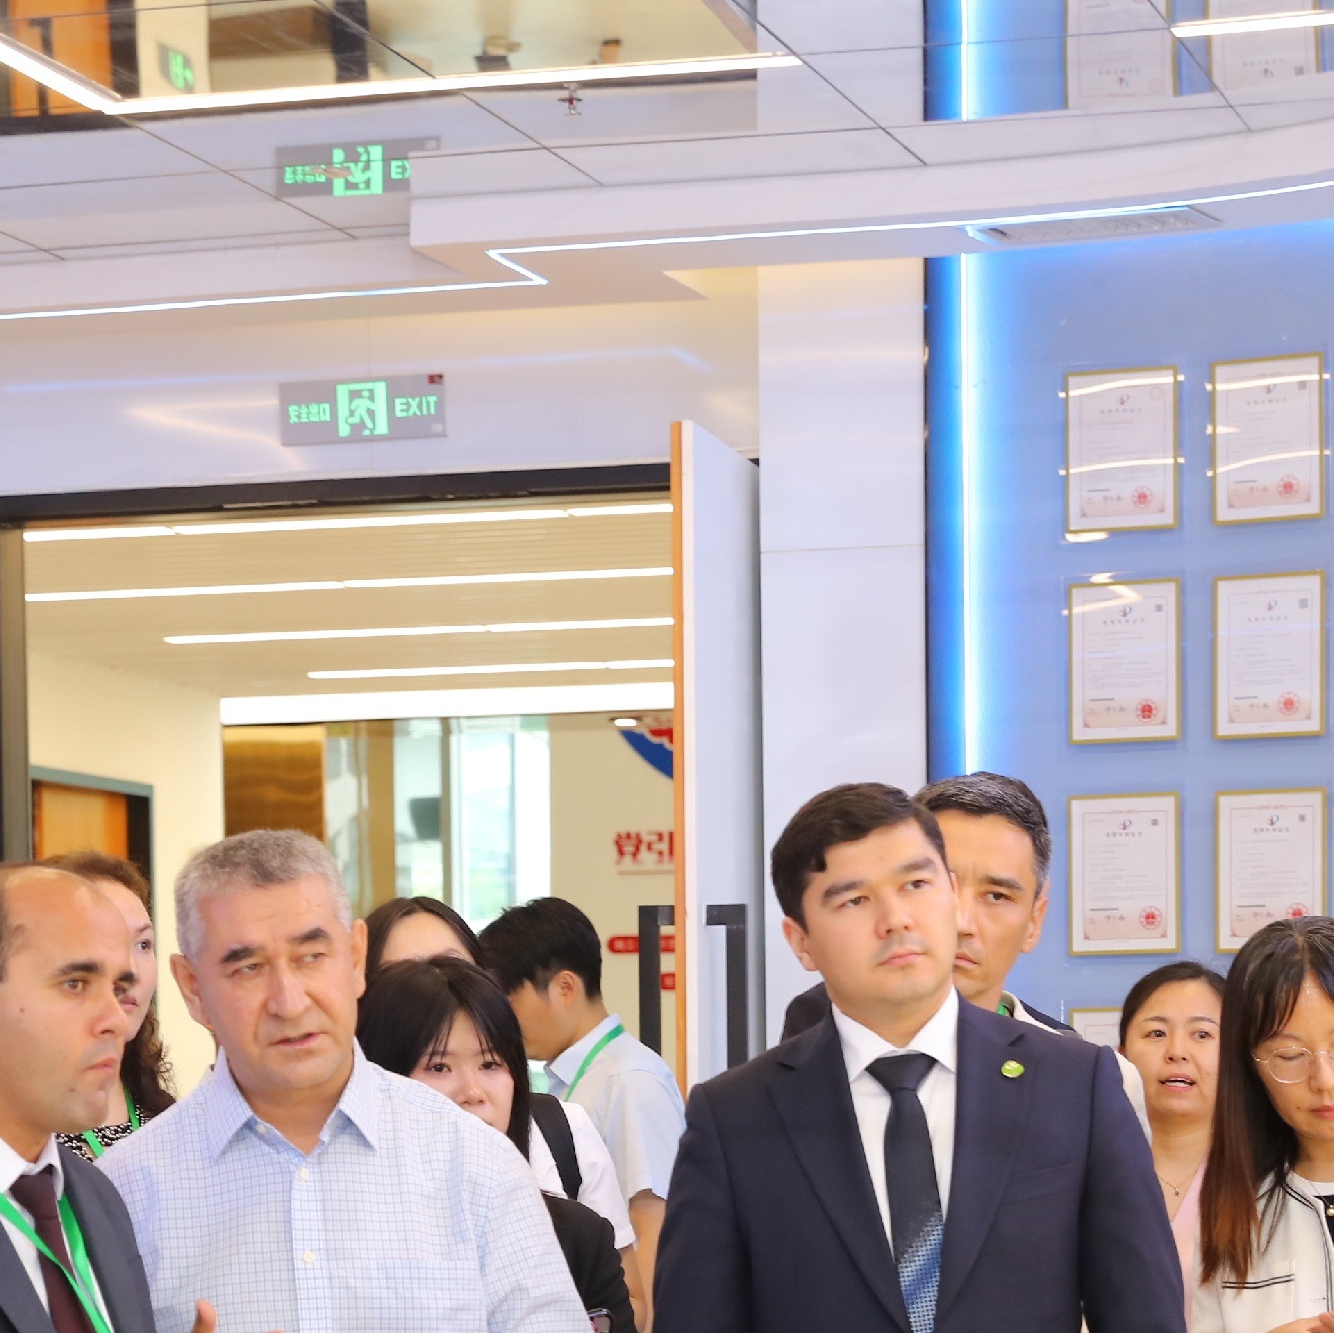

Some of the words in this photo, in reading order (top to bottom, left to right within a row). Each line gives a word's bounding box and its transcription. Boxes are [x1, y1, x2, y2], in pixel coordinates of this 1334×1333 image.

[288, 403, 330, 424] 安全出口
[394, 395, 438, 417] EXIT
